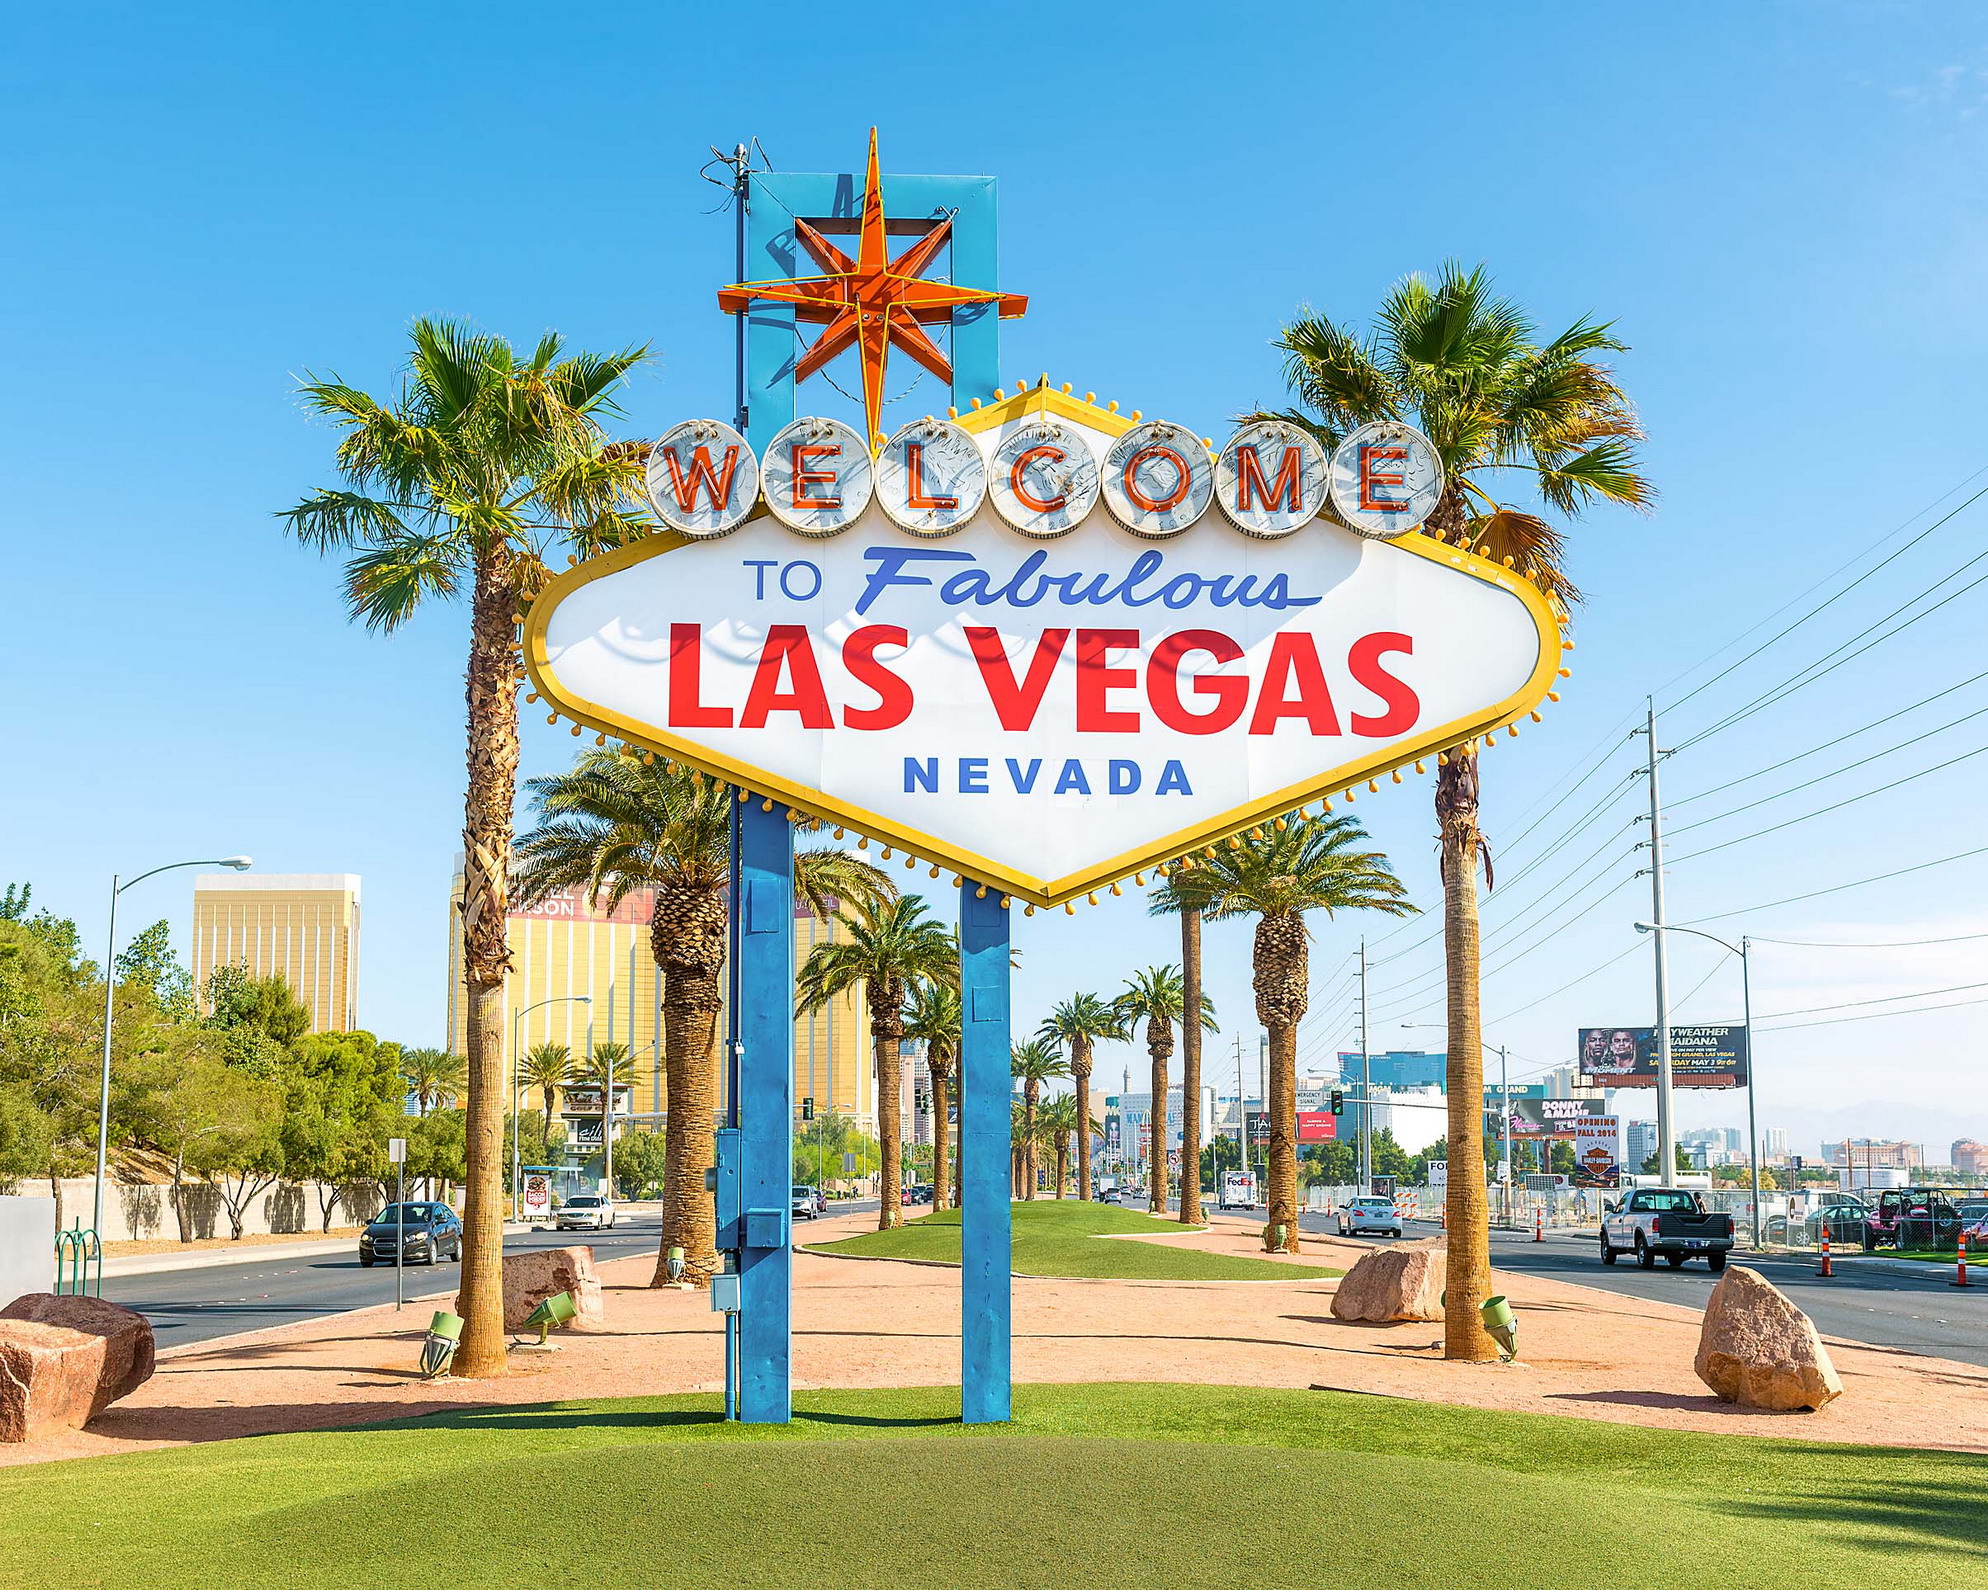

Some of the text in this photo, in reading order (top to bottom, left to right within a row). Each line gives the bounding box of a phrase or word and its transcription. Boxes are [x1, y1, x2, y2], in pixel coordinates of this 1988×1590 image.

[662, 441, 1409, 514] WELCOME
[743, 547, 1322, 616] TO Fabulous
[669, 623, 1420, 738] LAS VEGAS
[903, 757, 1193, 796] NEVADA
[1541, 1100, 1584, 1110] DONNY
[1577, 1118, 1616, 1126] OPENING
[1577, 1129, 1595, 1137] FALL
[1227, 1177, 1254, 1186] FedEx
